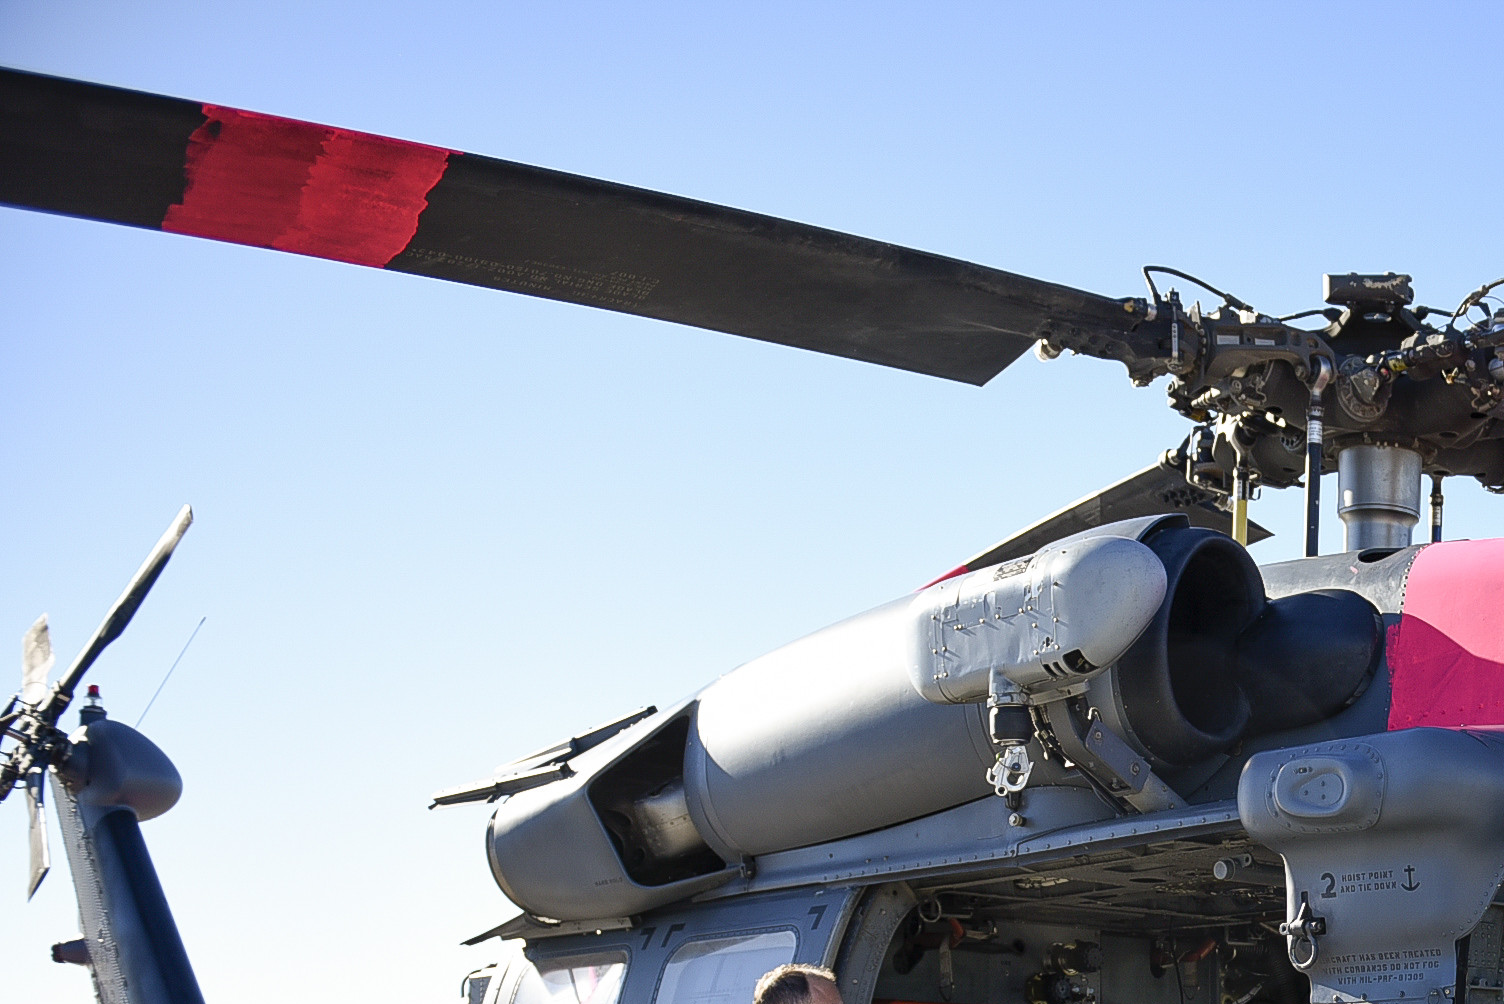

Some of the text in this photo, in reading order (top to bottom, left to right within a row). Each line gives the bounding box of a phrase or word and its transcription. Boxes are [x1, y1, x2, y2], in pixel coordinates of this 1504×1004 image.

[1341, 870, 1394, 882] HOIST POINT
[1320, 872, 1337, 899] 2
[1340, 881, 1397, 893] AND TIE DOWN
[1359, 953, 1376, 962] HAS
[1378, 951, 1401, 960] BEEN
[1402, 949, 1442, 959] TREATED
[1390, 963, 1401, 971] DO
[1403, 961, 1420, 970] NOT
[1422, 960, 1440, 969] FOG
[1337, 976, 1357, 985] WITH
